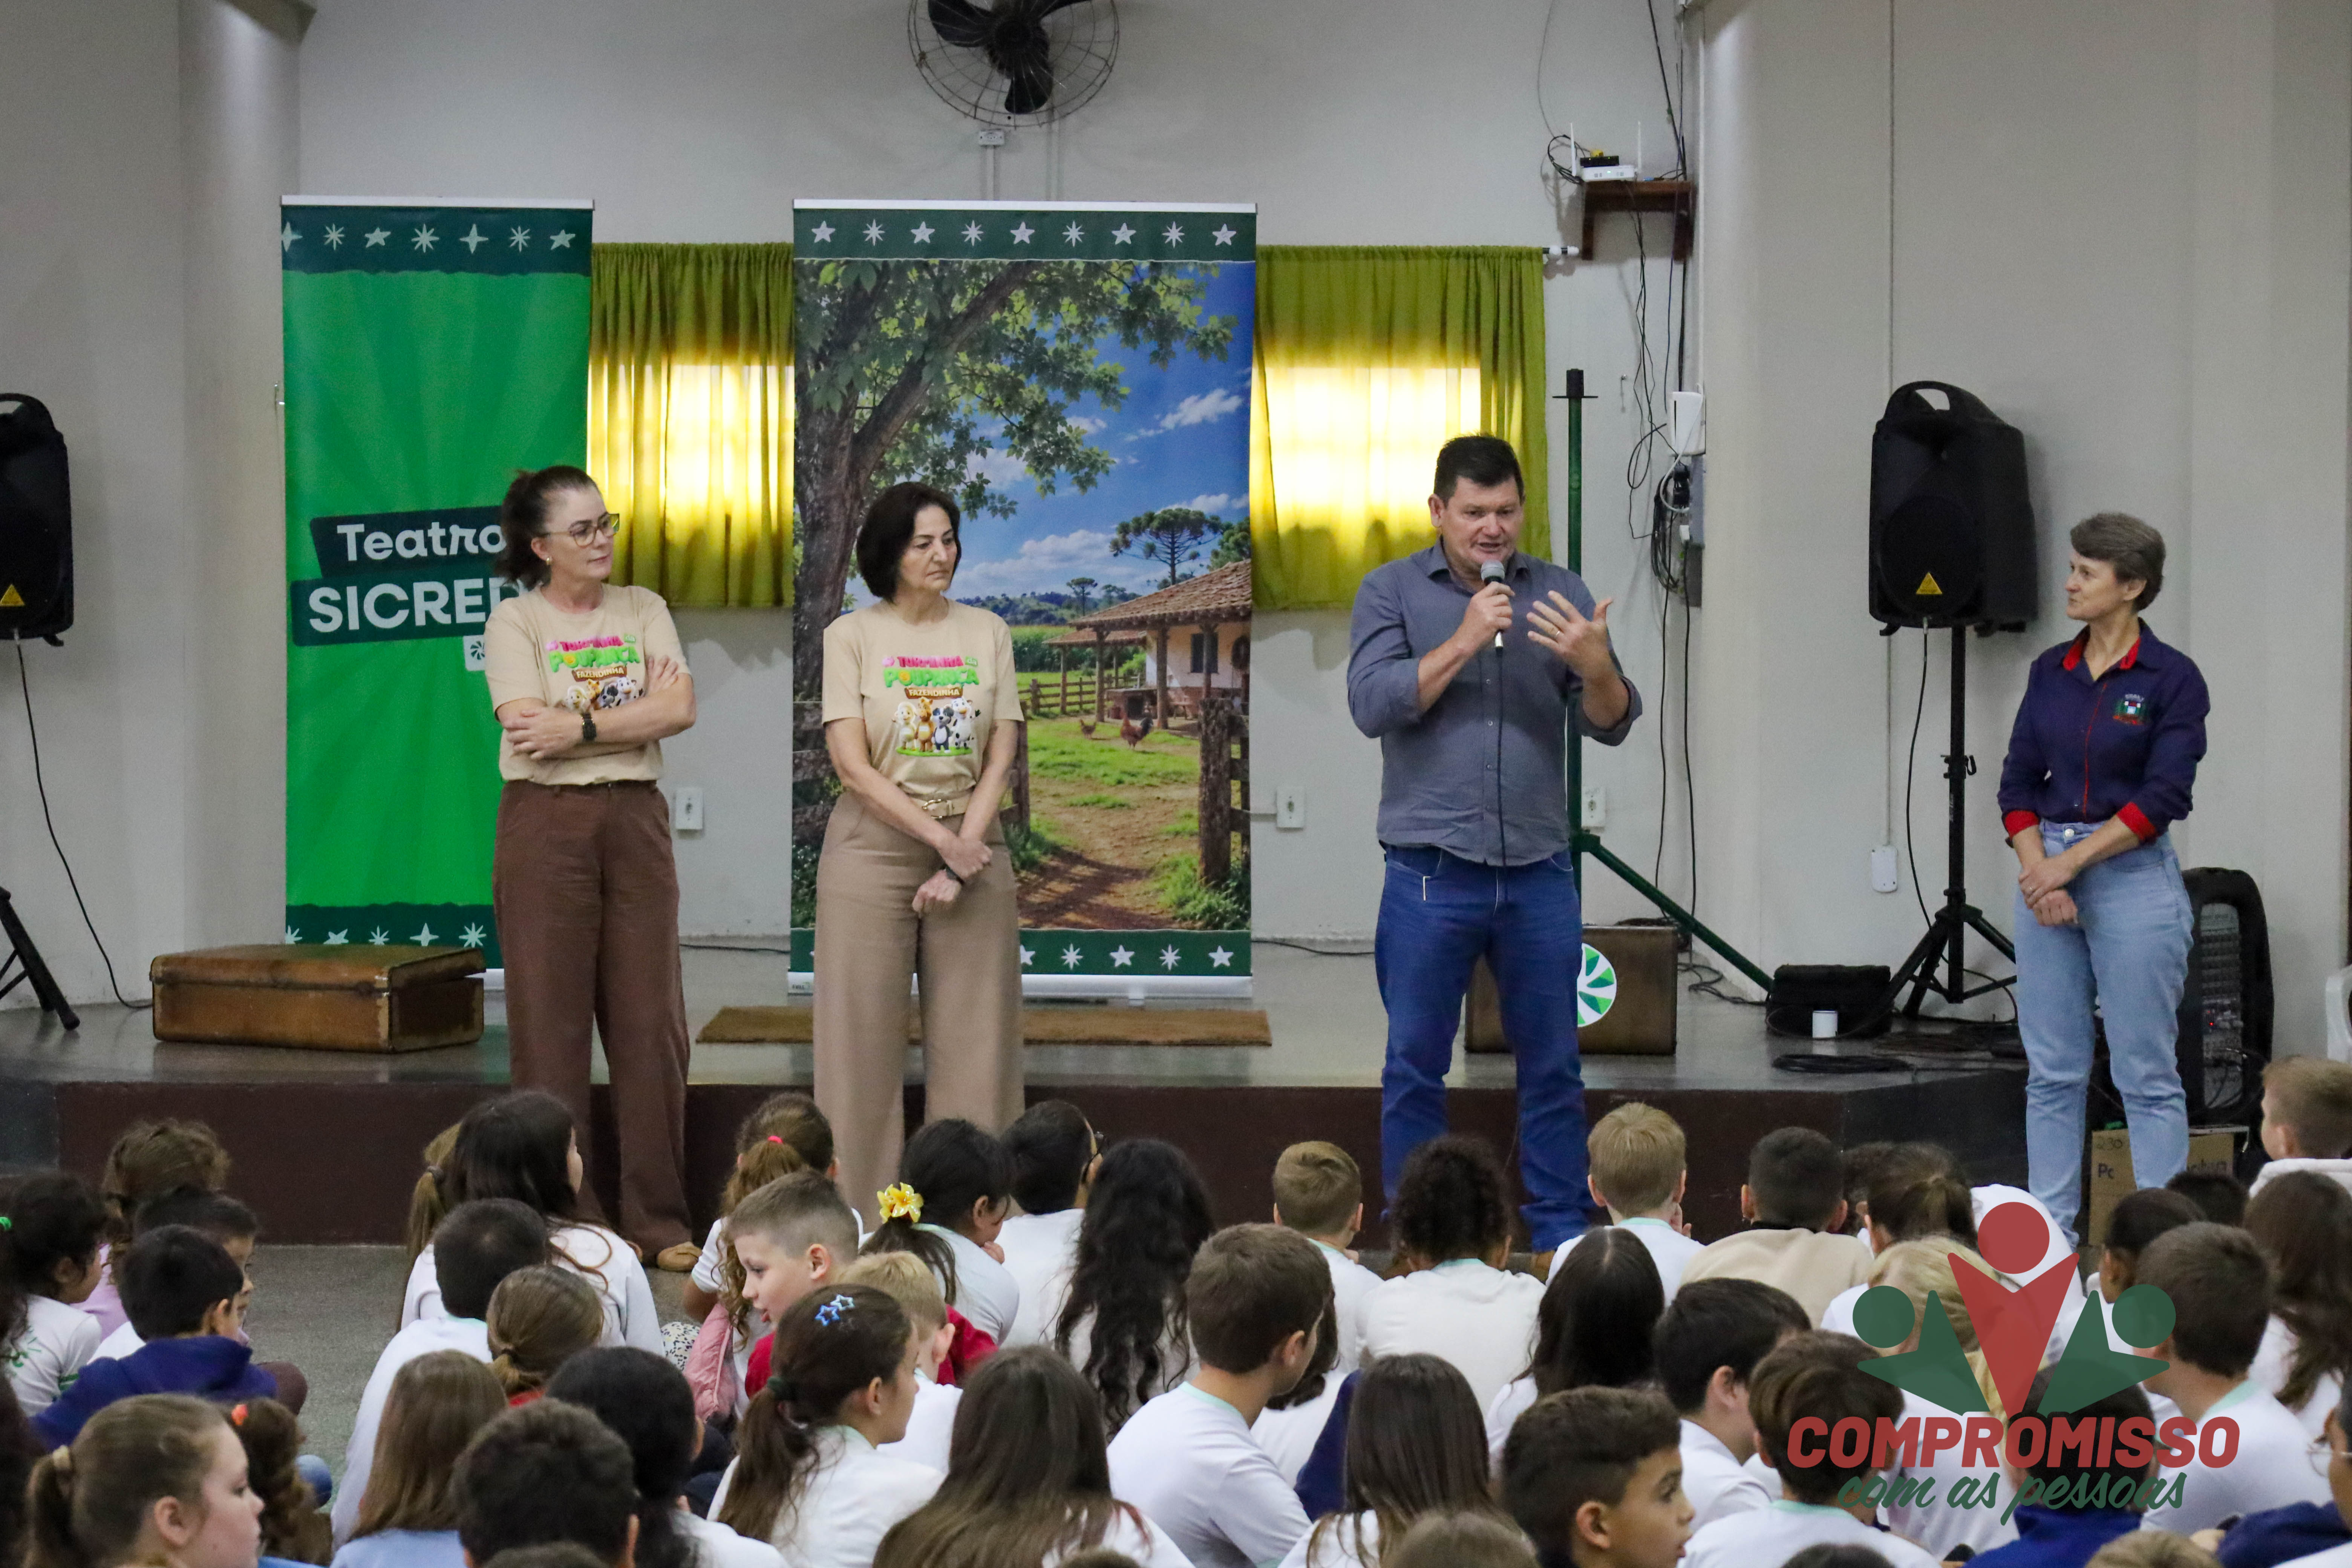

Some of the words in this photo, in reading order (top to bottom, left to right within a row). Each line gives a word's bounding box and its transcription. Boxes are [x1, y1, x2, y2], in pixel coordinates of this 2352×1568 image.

[337, 522, 507, 561] Teatro
[576, 667, 625, 678] FAZENDINHA
[908, 688, 960, 697] FAZENDINHA
